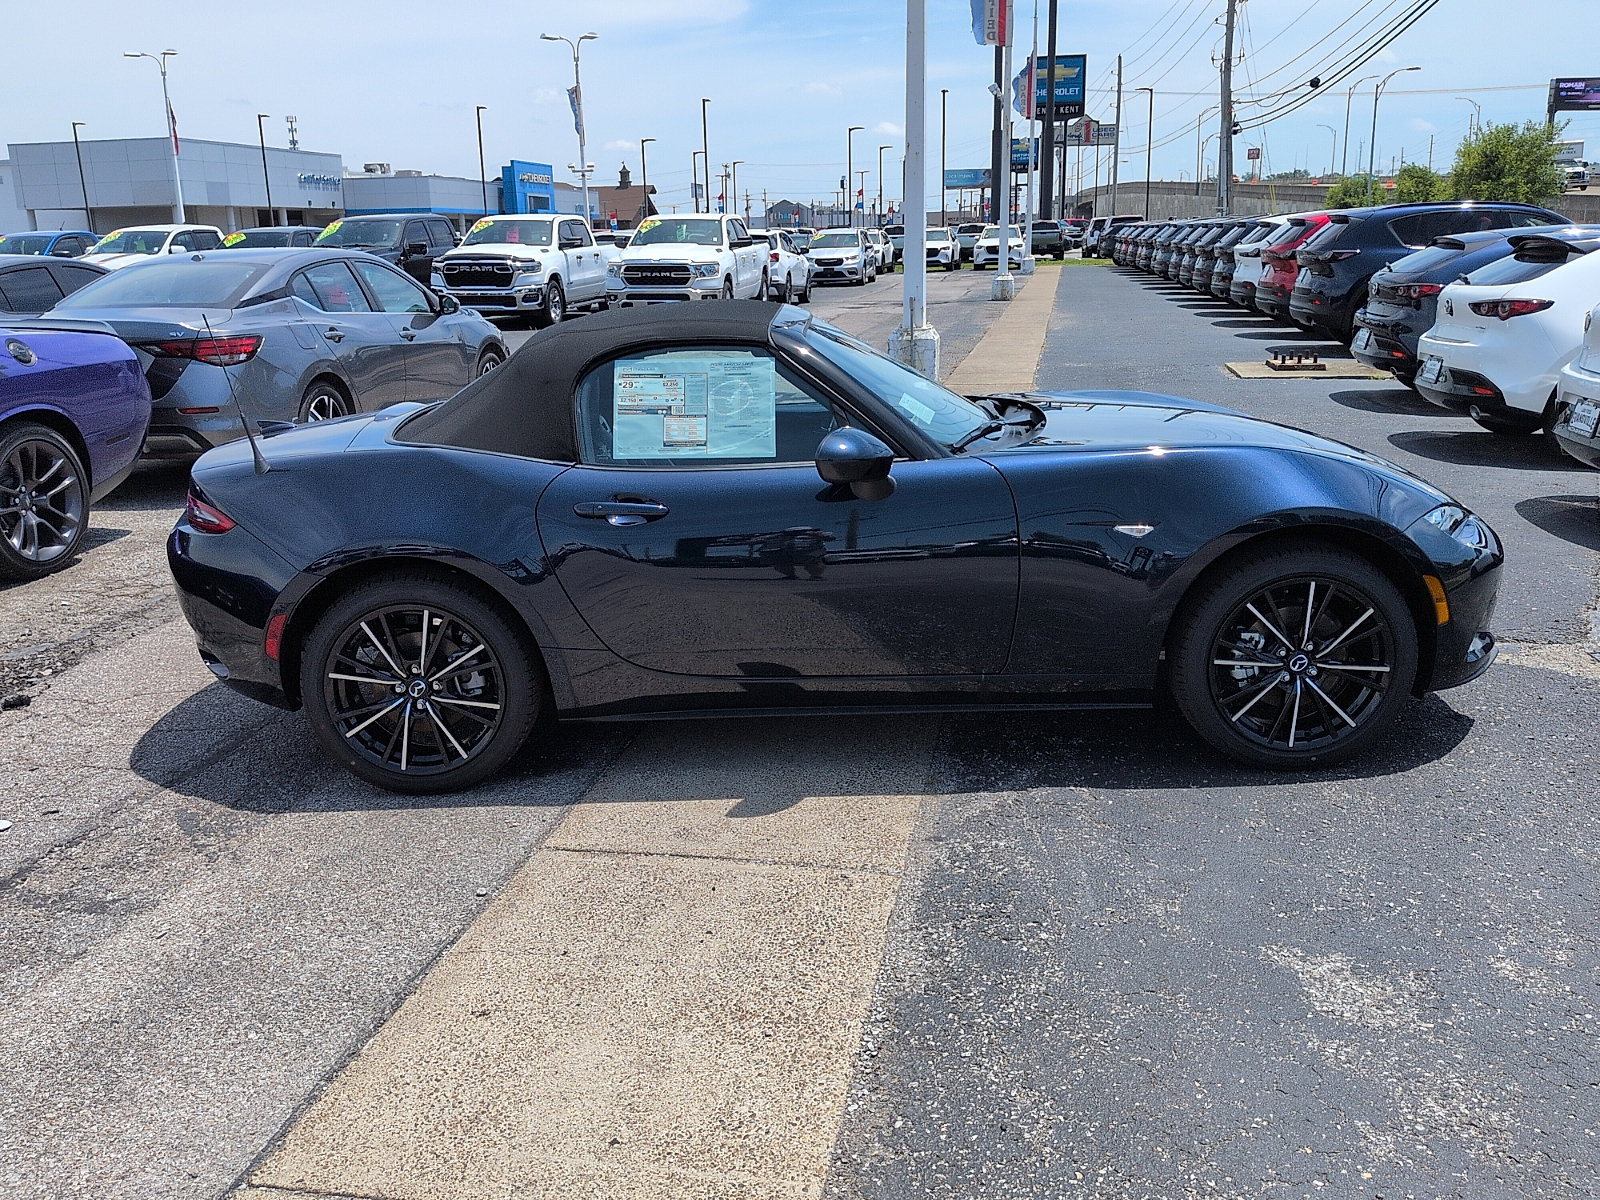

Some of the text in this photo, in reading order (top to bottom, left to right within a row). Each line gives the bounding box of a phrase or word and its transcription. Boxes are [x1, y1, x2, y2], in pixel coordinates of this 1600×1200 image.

[1036, 87, 1080, 96] HEROLET
[1060, 105, 1079, 113] KENT
[622, 381, 634, 389] 29
